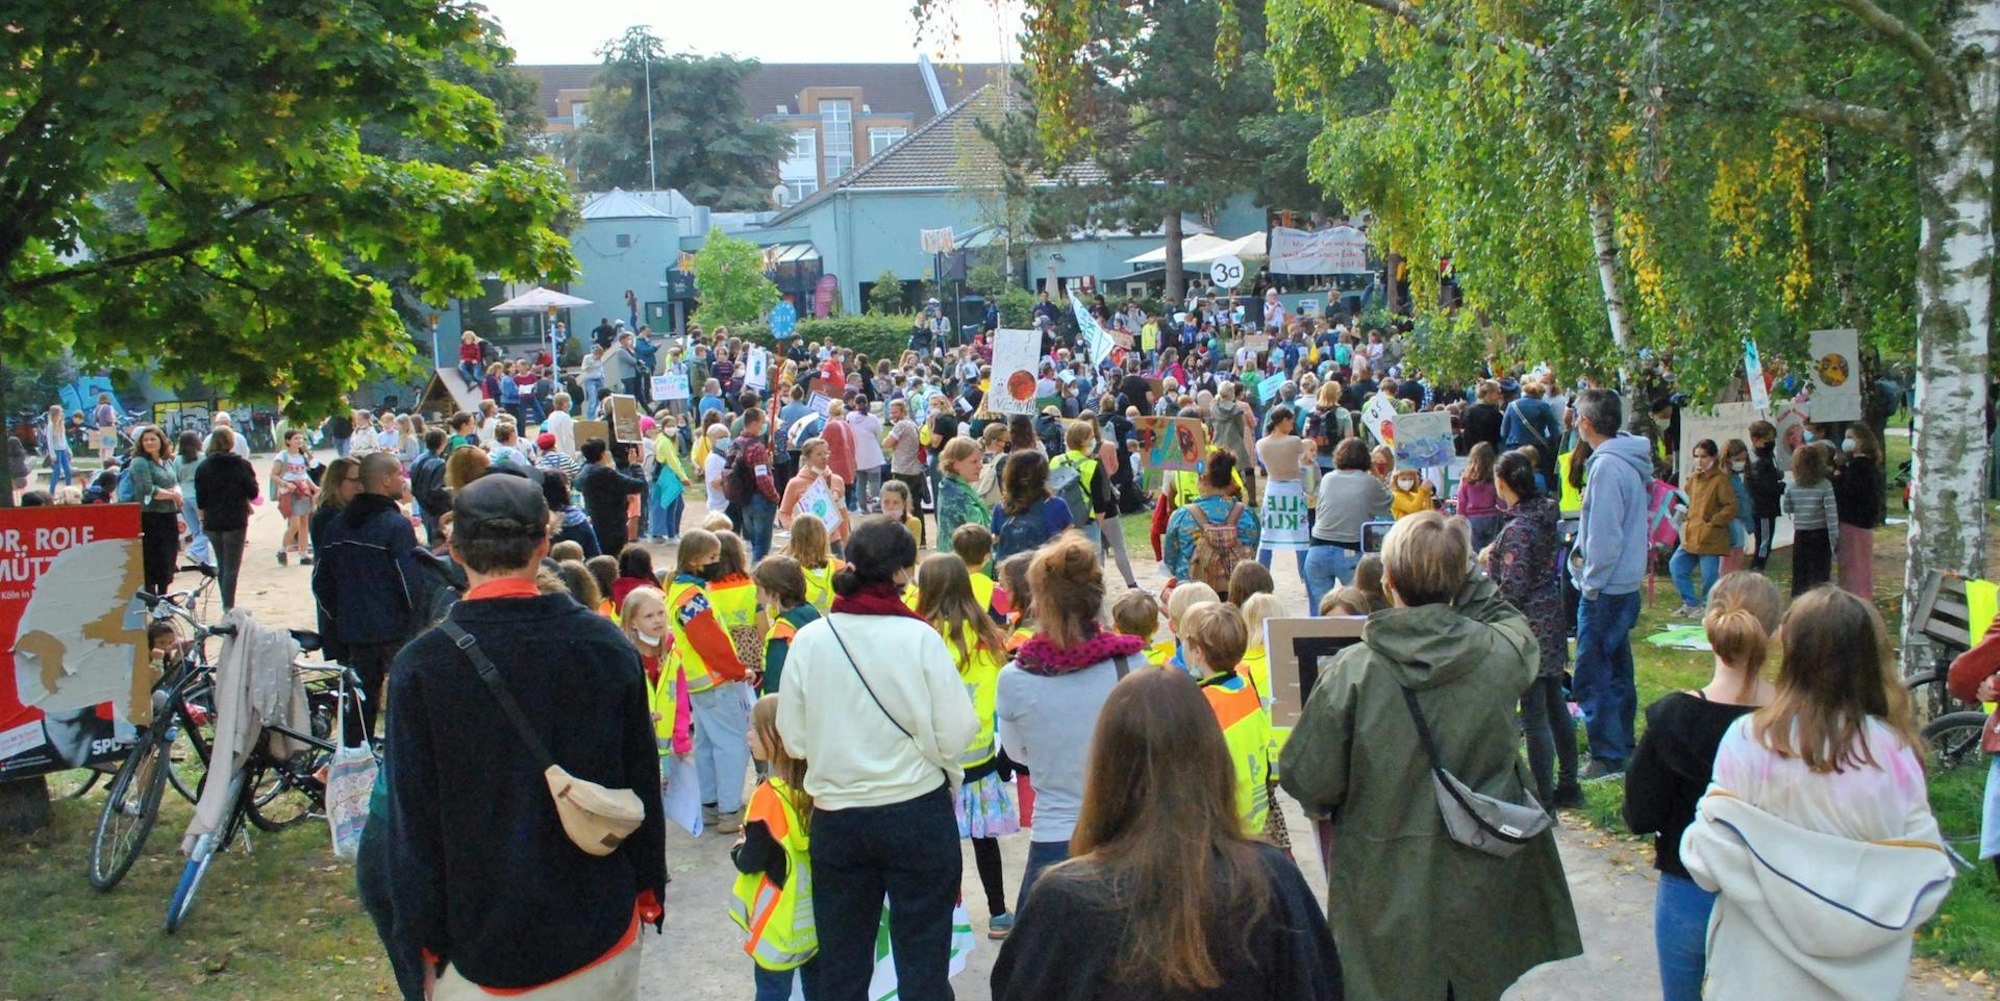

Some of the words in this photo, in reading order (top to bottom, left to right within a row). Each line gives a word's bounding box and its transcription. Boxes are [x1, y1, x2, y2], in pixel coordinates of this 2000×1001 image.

[1214, 263, 1240, 282] 3a
[0, 528, 28, 552] R.
[1, 590, 20, 600] Köln
[22, 590, 30, 599] in
